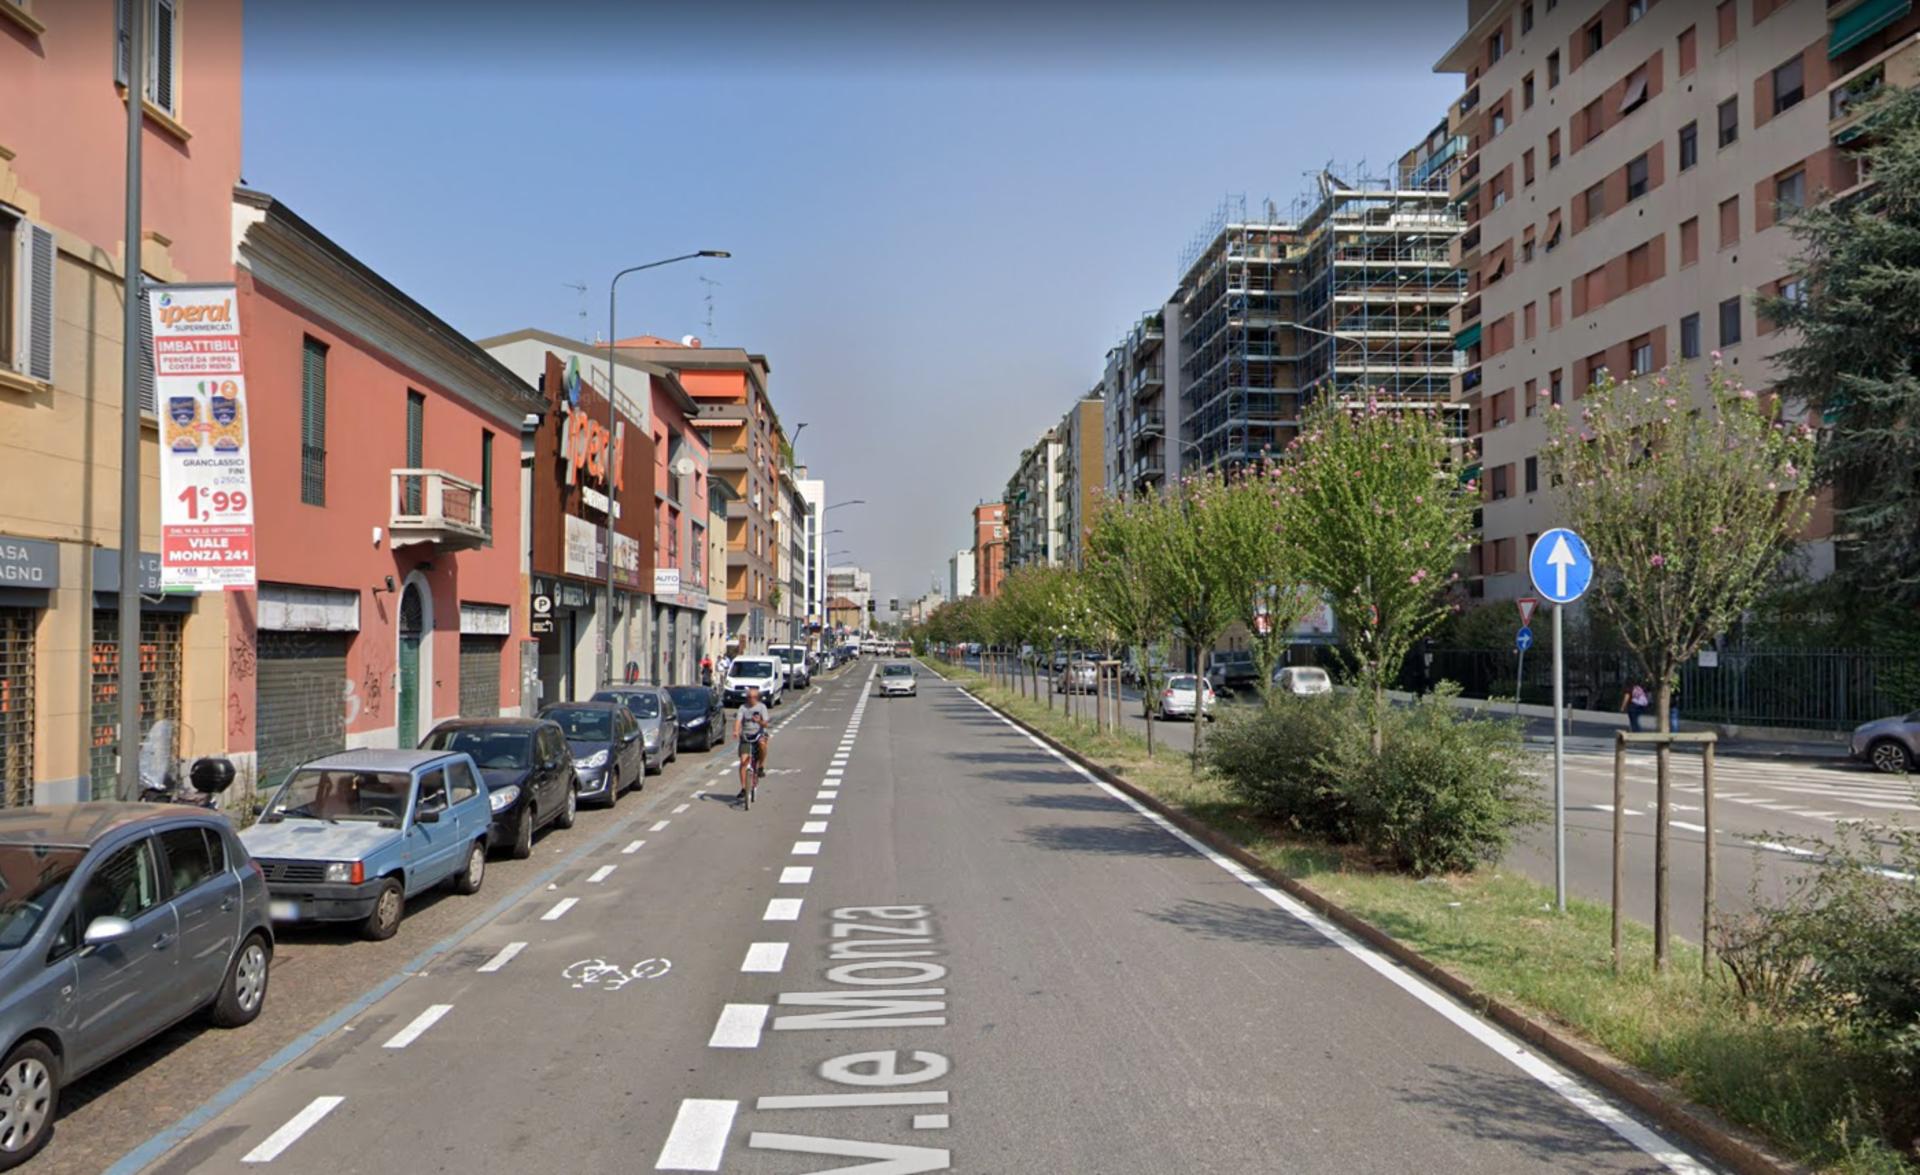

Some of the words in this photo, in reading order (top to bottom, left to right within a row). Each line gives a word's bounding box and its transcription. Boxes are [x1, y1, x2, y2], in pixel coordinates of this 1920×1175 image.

[158, 339, 238, 352] IMBATTIBILI
[183, 458, 245, 467] GRANCLASSICI
[188, 537, 229, 548] VIALE
[169, 550, 221, 561] MONZA
[224, 550, 249, 561] 241
[538, 598, 548, 610] P
[772, 904, 948, 1031] Monza
